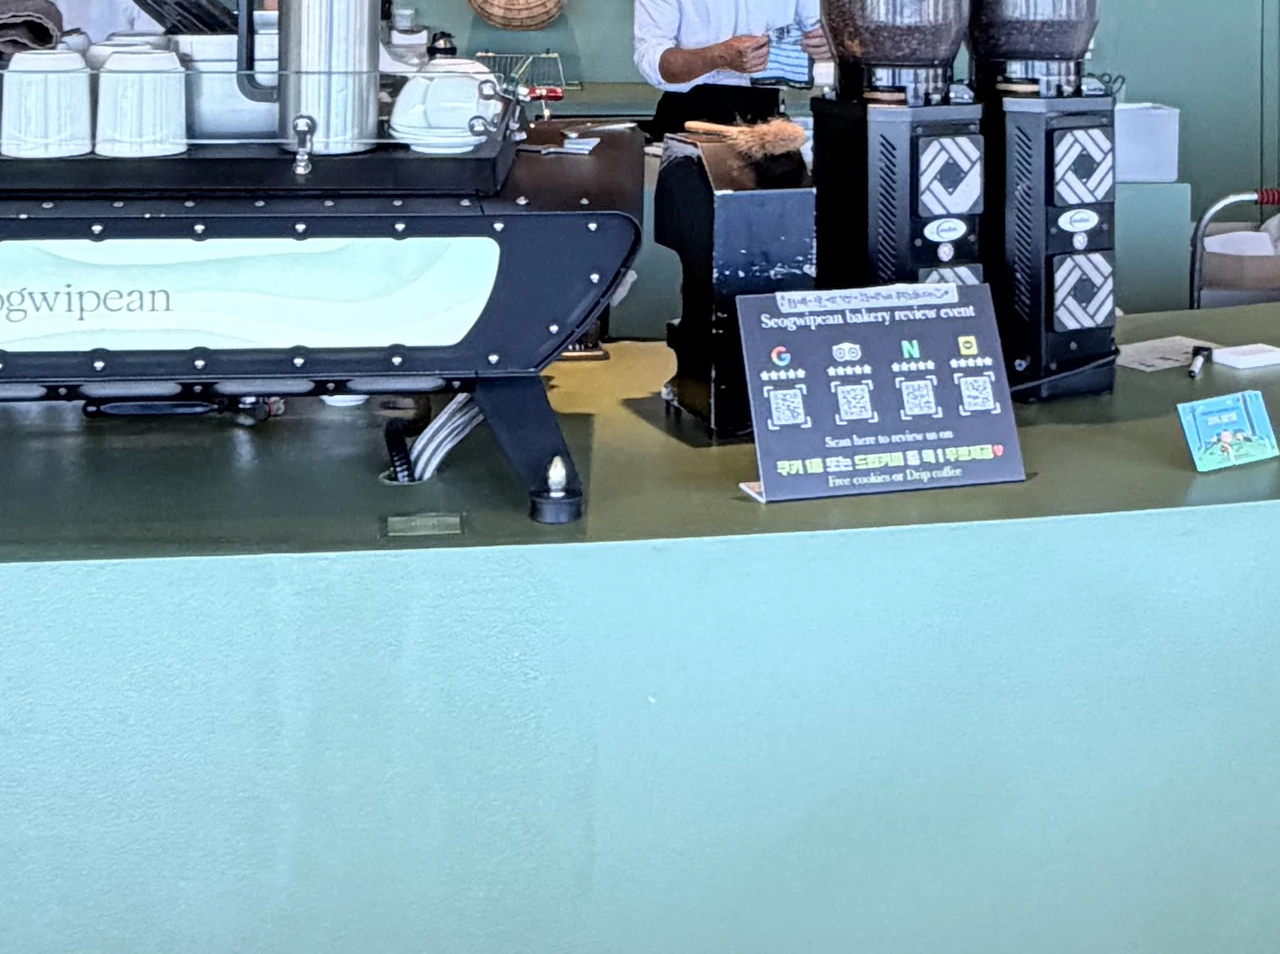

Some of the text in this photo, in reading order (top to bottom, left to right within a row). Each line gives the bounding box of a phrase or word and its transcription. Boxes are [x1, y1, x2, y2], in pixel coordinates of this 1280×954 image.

[760, 305, 976, 332] Seogwipean bakery review event
[900, 339, 920, 359] N
[824, 435, 852, 448] Scan
[852, 434, 876, 446] here
[877, 434, 890, 444] to
[891, 430, 924, 443] review
[938, 430, 954, 440] on
[827, 465, 963, 488] Free cookies or Drip coffee
